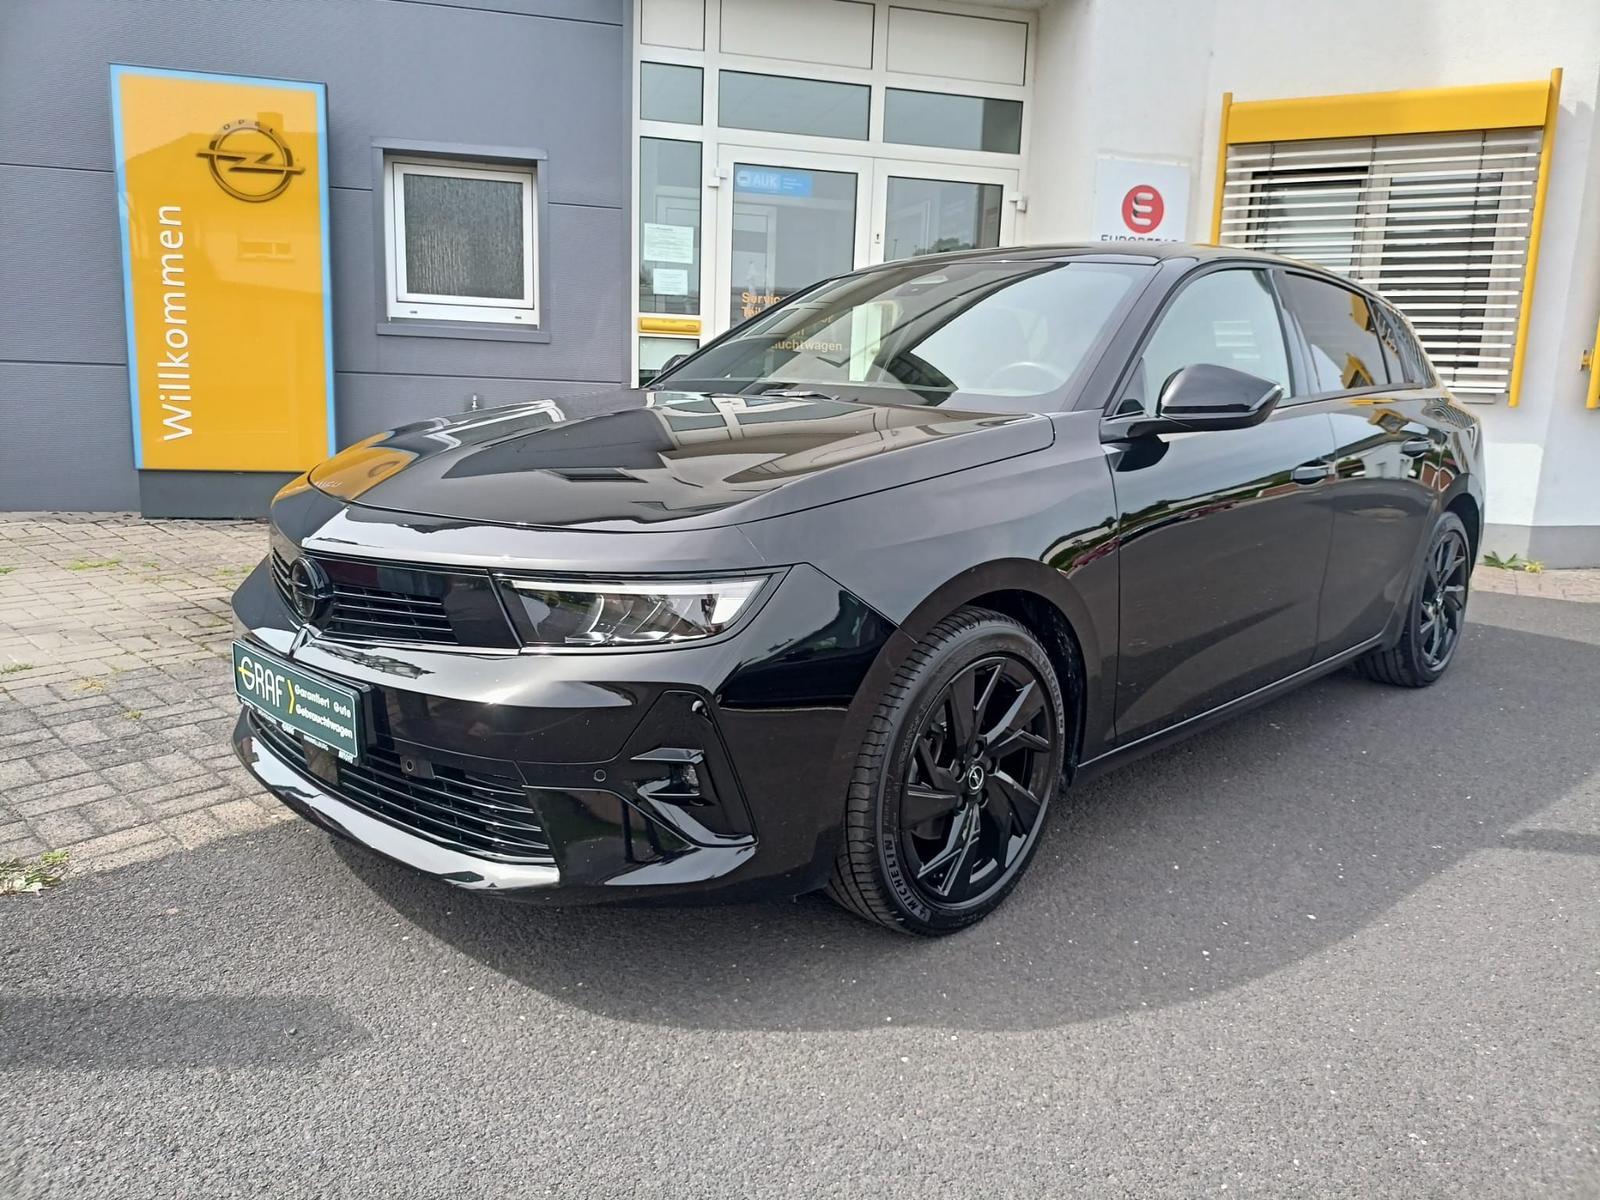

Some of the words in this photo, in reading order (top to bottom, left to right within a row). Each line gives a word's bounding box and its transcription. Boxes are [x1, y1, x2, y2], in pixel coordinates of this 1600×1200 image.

[223, 119, 274, 135] OPEL
[742, 292, 783, 305] Servic
[157, 205, 192, 441] Willkommen
[239, 656, 285, 707] GRAF
[333, 701, 351, 718] Gute
[884, 840, 919, 911] MICHELIN
